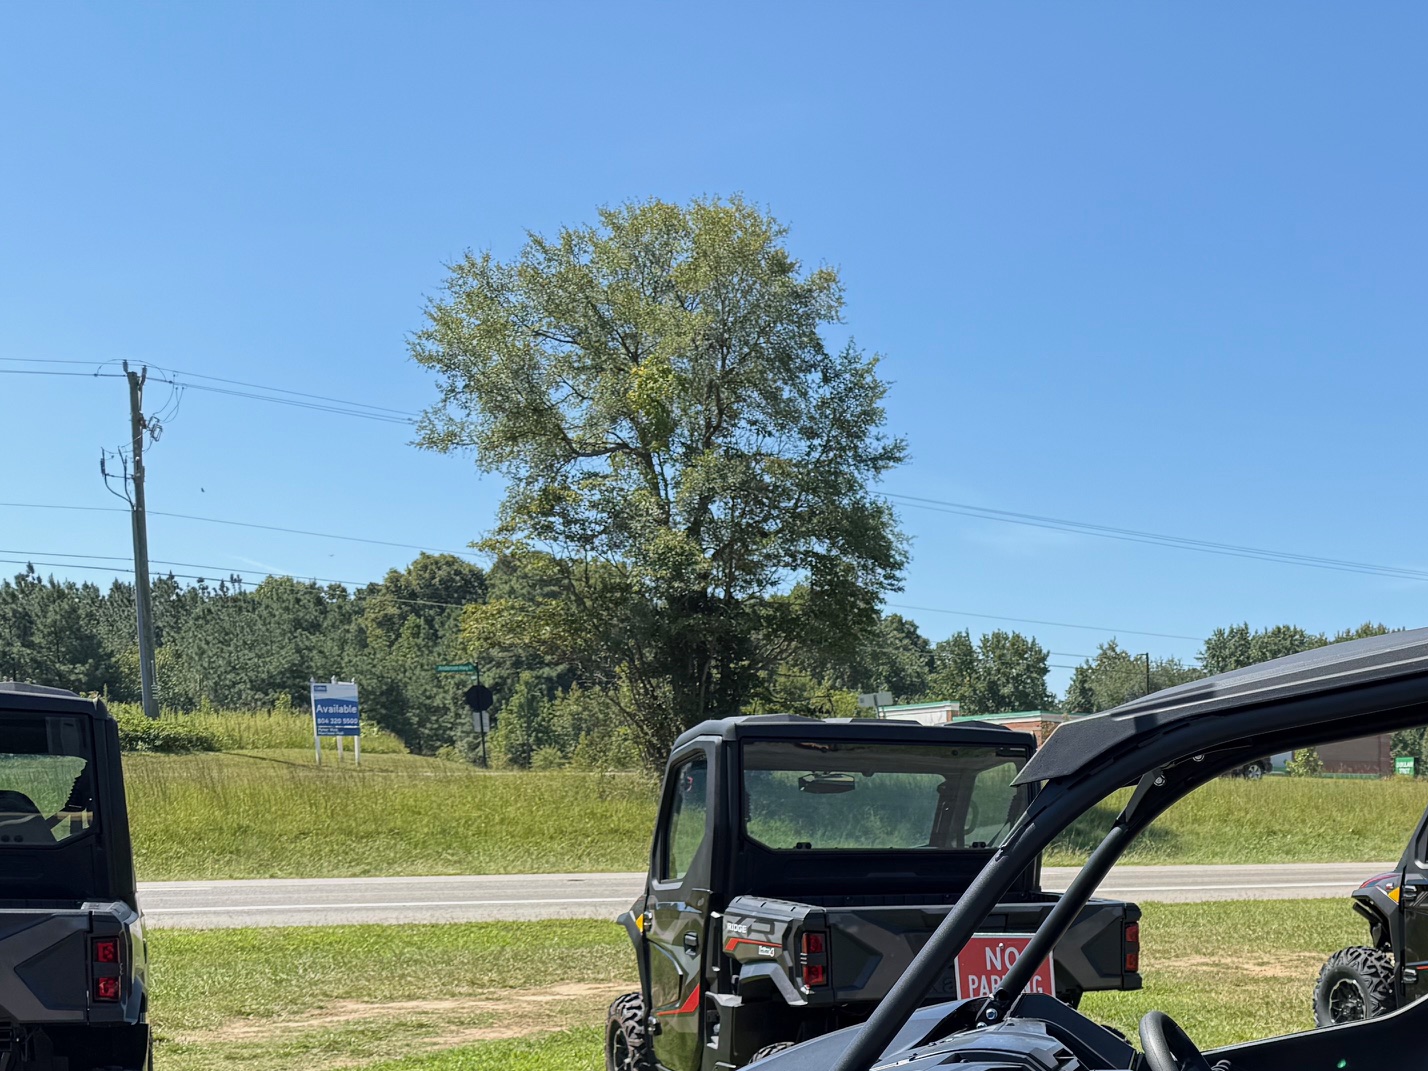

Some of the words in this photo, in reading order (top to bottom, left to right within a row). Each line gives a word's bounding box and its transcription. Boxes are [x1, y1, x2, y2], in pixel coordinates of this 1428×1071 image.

[316, 704, 358, 714] Available
[726, 922, 748, 934] RIDGE
[985, 946, 1021, 971] NO
[968, 974, 1043, 999] PARG
